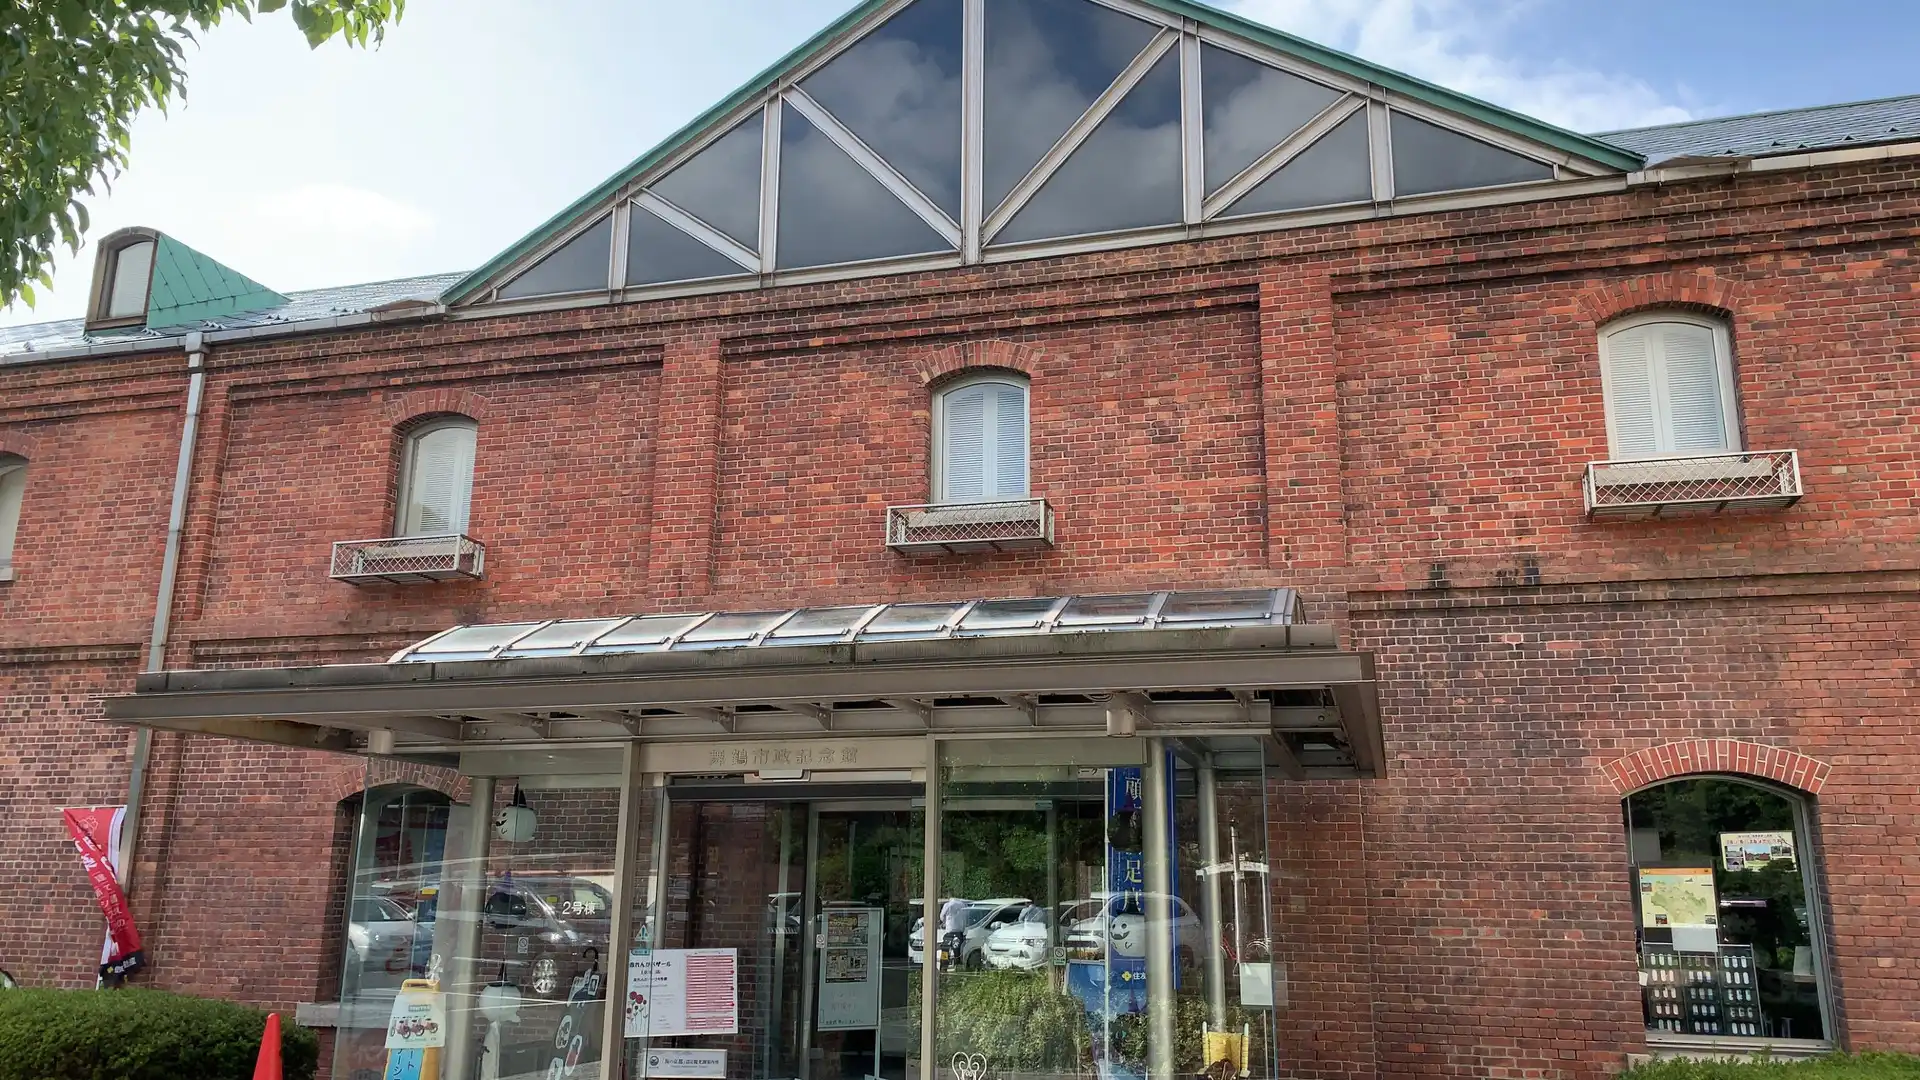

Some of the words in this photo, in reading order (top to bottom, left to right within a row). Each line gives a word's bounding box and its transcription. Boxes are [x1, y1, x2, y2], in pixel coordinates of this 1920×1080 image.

[709, 747, 858, 766] 舞鶴市政記念館
[562, 900, 596, 916] 2号棟
